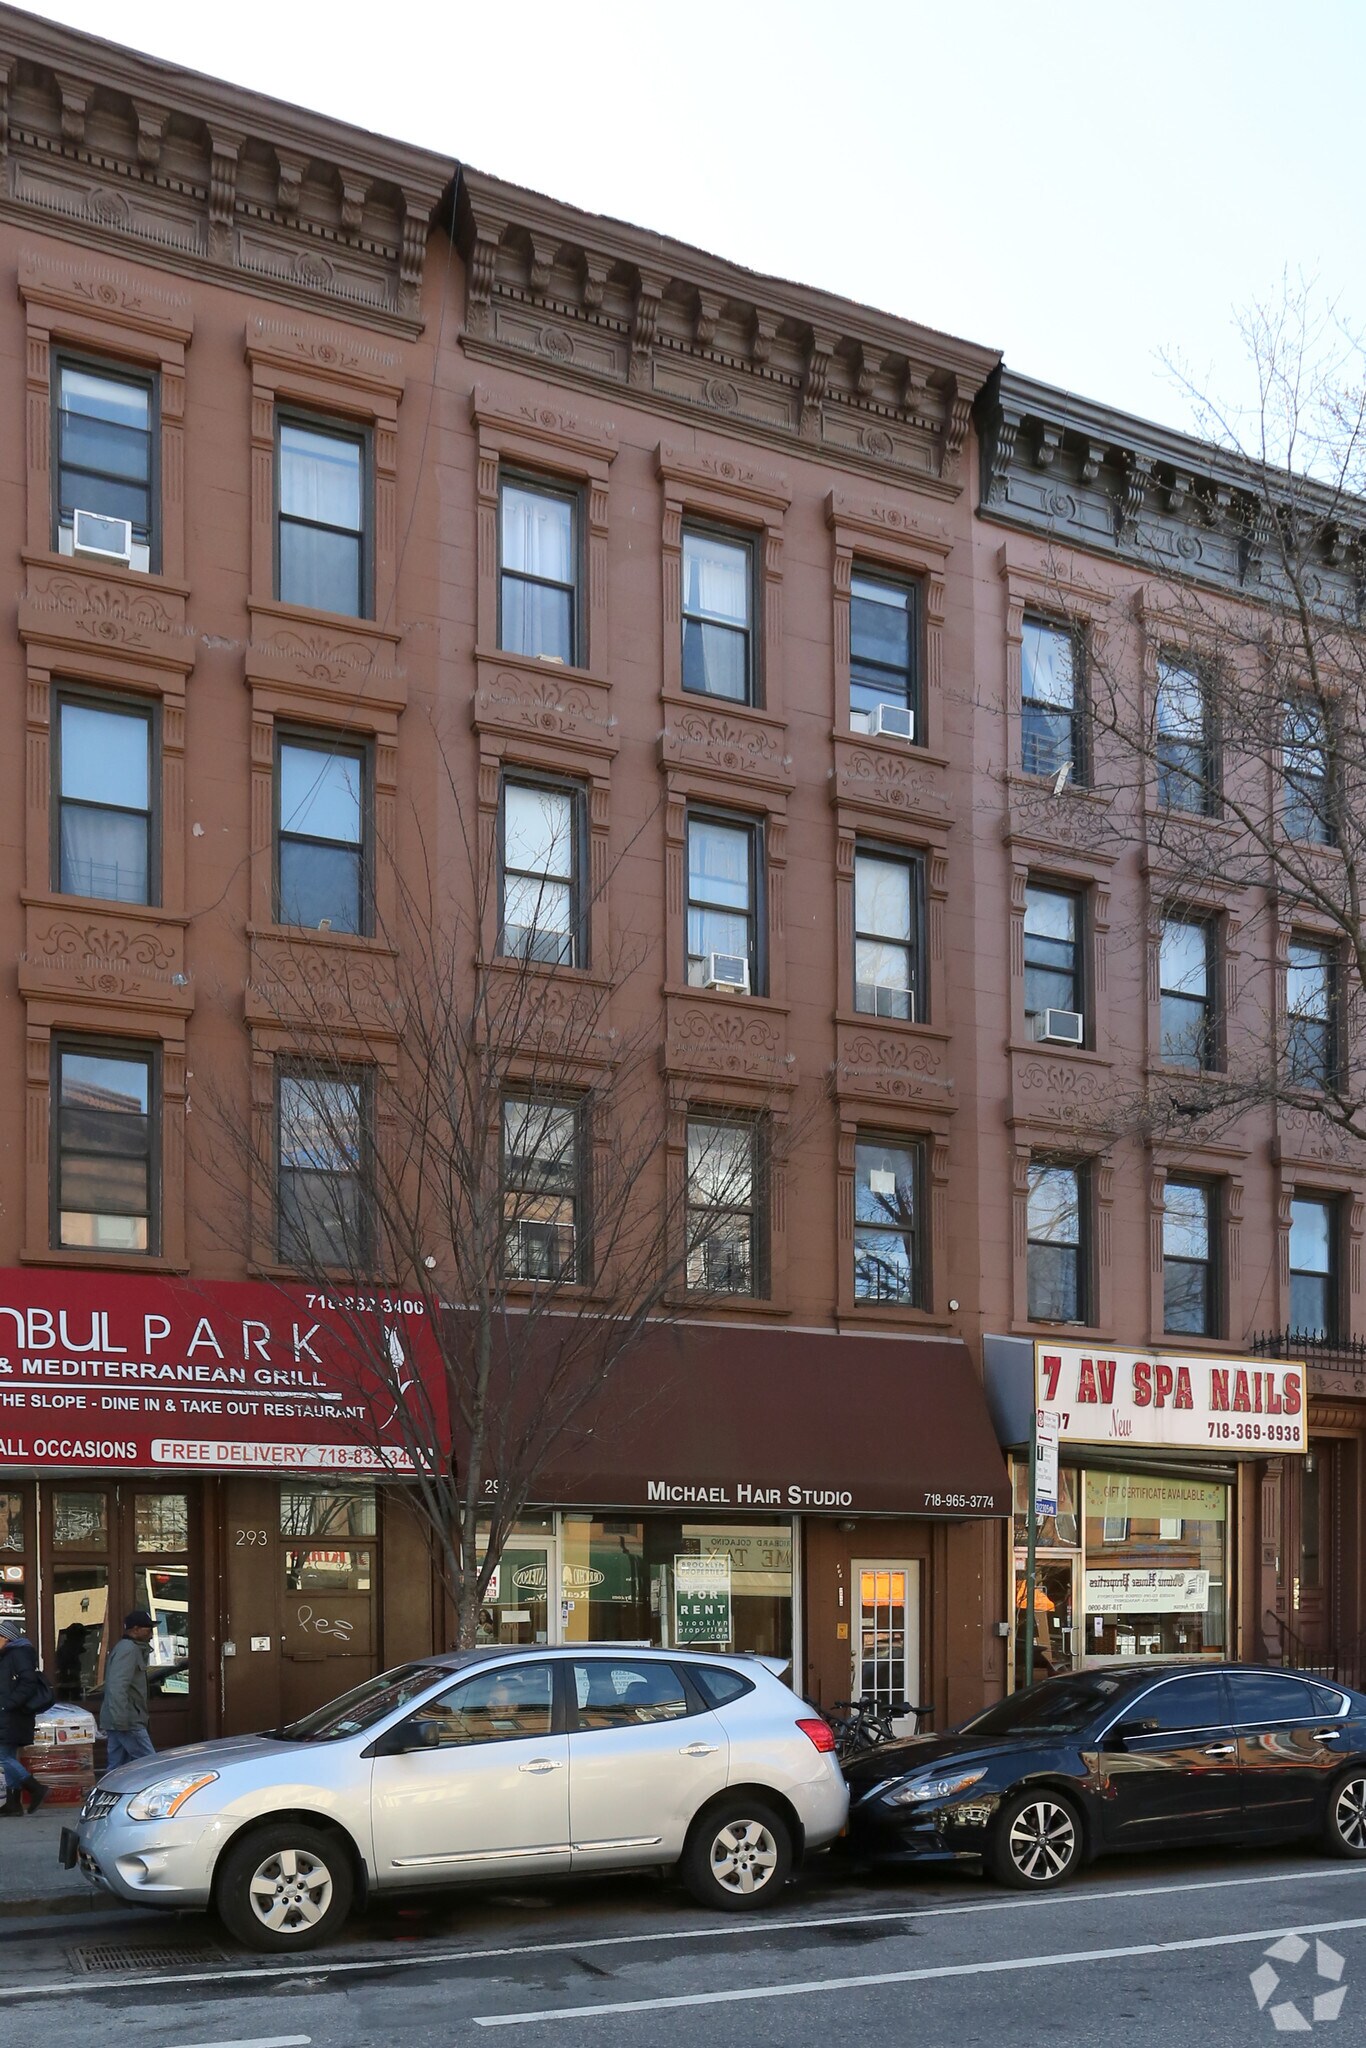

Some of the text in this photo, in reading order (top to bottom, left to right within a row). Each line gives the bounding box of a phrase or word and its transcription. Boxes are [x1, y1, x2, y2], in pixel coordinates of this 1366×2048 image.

[144, 1314, 323, 1363] PARK
[22, 1358, 246, 1384] MEDITERRANEAN
[254, 1368, 327, 1387] GRILL
[1042, 1356, 1300, 1415] 7 AV SPA NAILS
[30, 1394, 87, 1409] SLOPE
[101, 1397, 140, 1411] DINE
[144, 1398, 160, 1412] IN
[165, 1399, 177, 1413] &
[181, 1400, 223, 1415] TAKE
[226, 1402, 259, 1416] OUT
[264, 1403, 366, 1419] RESTAURANT
[1109, 1408, 1133, 1437] New
[33, 1439, 138, 1459] OCCASIONS
[161, 1443, 210, 1460] FREE
[217, 1444, 308, 1464] DELIVERY
[924, 1493, 994, 1508] 718-965-3774
[1104, 1486, 1205, 1501] GIFT CERTIFICATE AVAILABLE
[236, 1530, 268, 1546] 293
[687, 1591, 718, 1600] FOR
[680, 1605, 726, 1615] RENT
